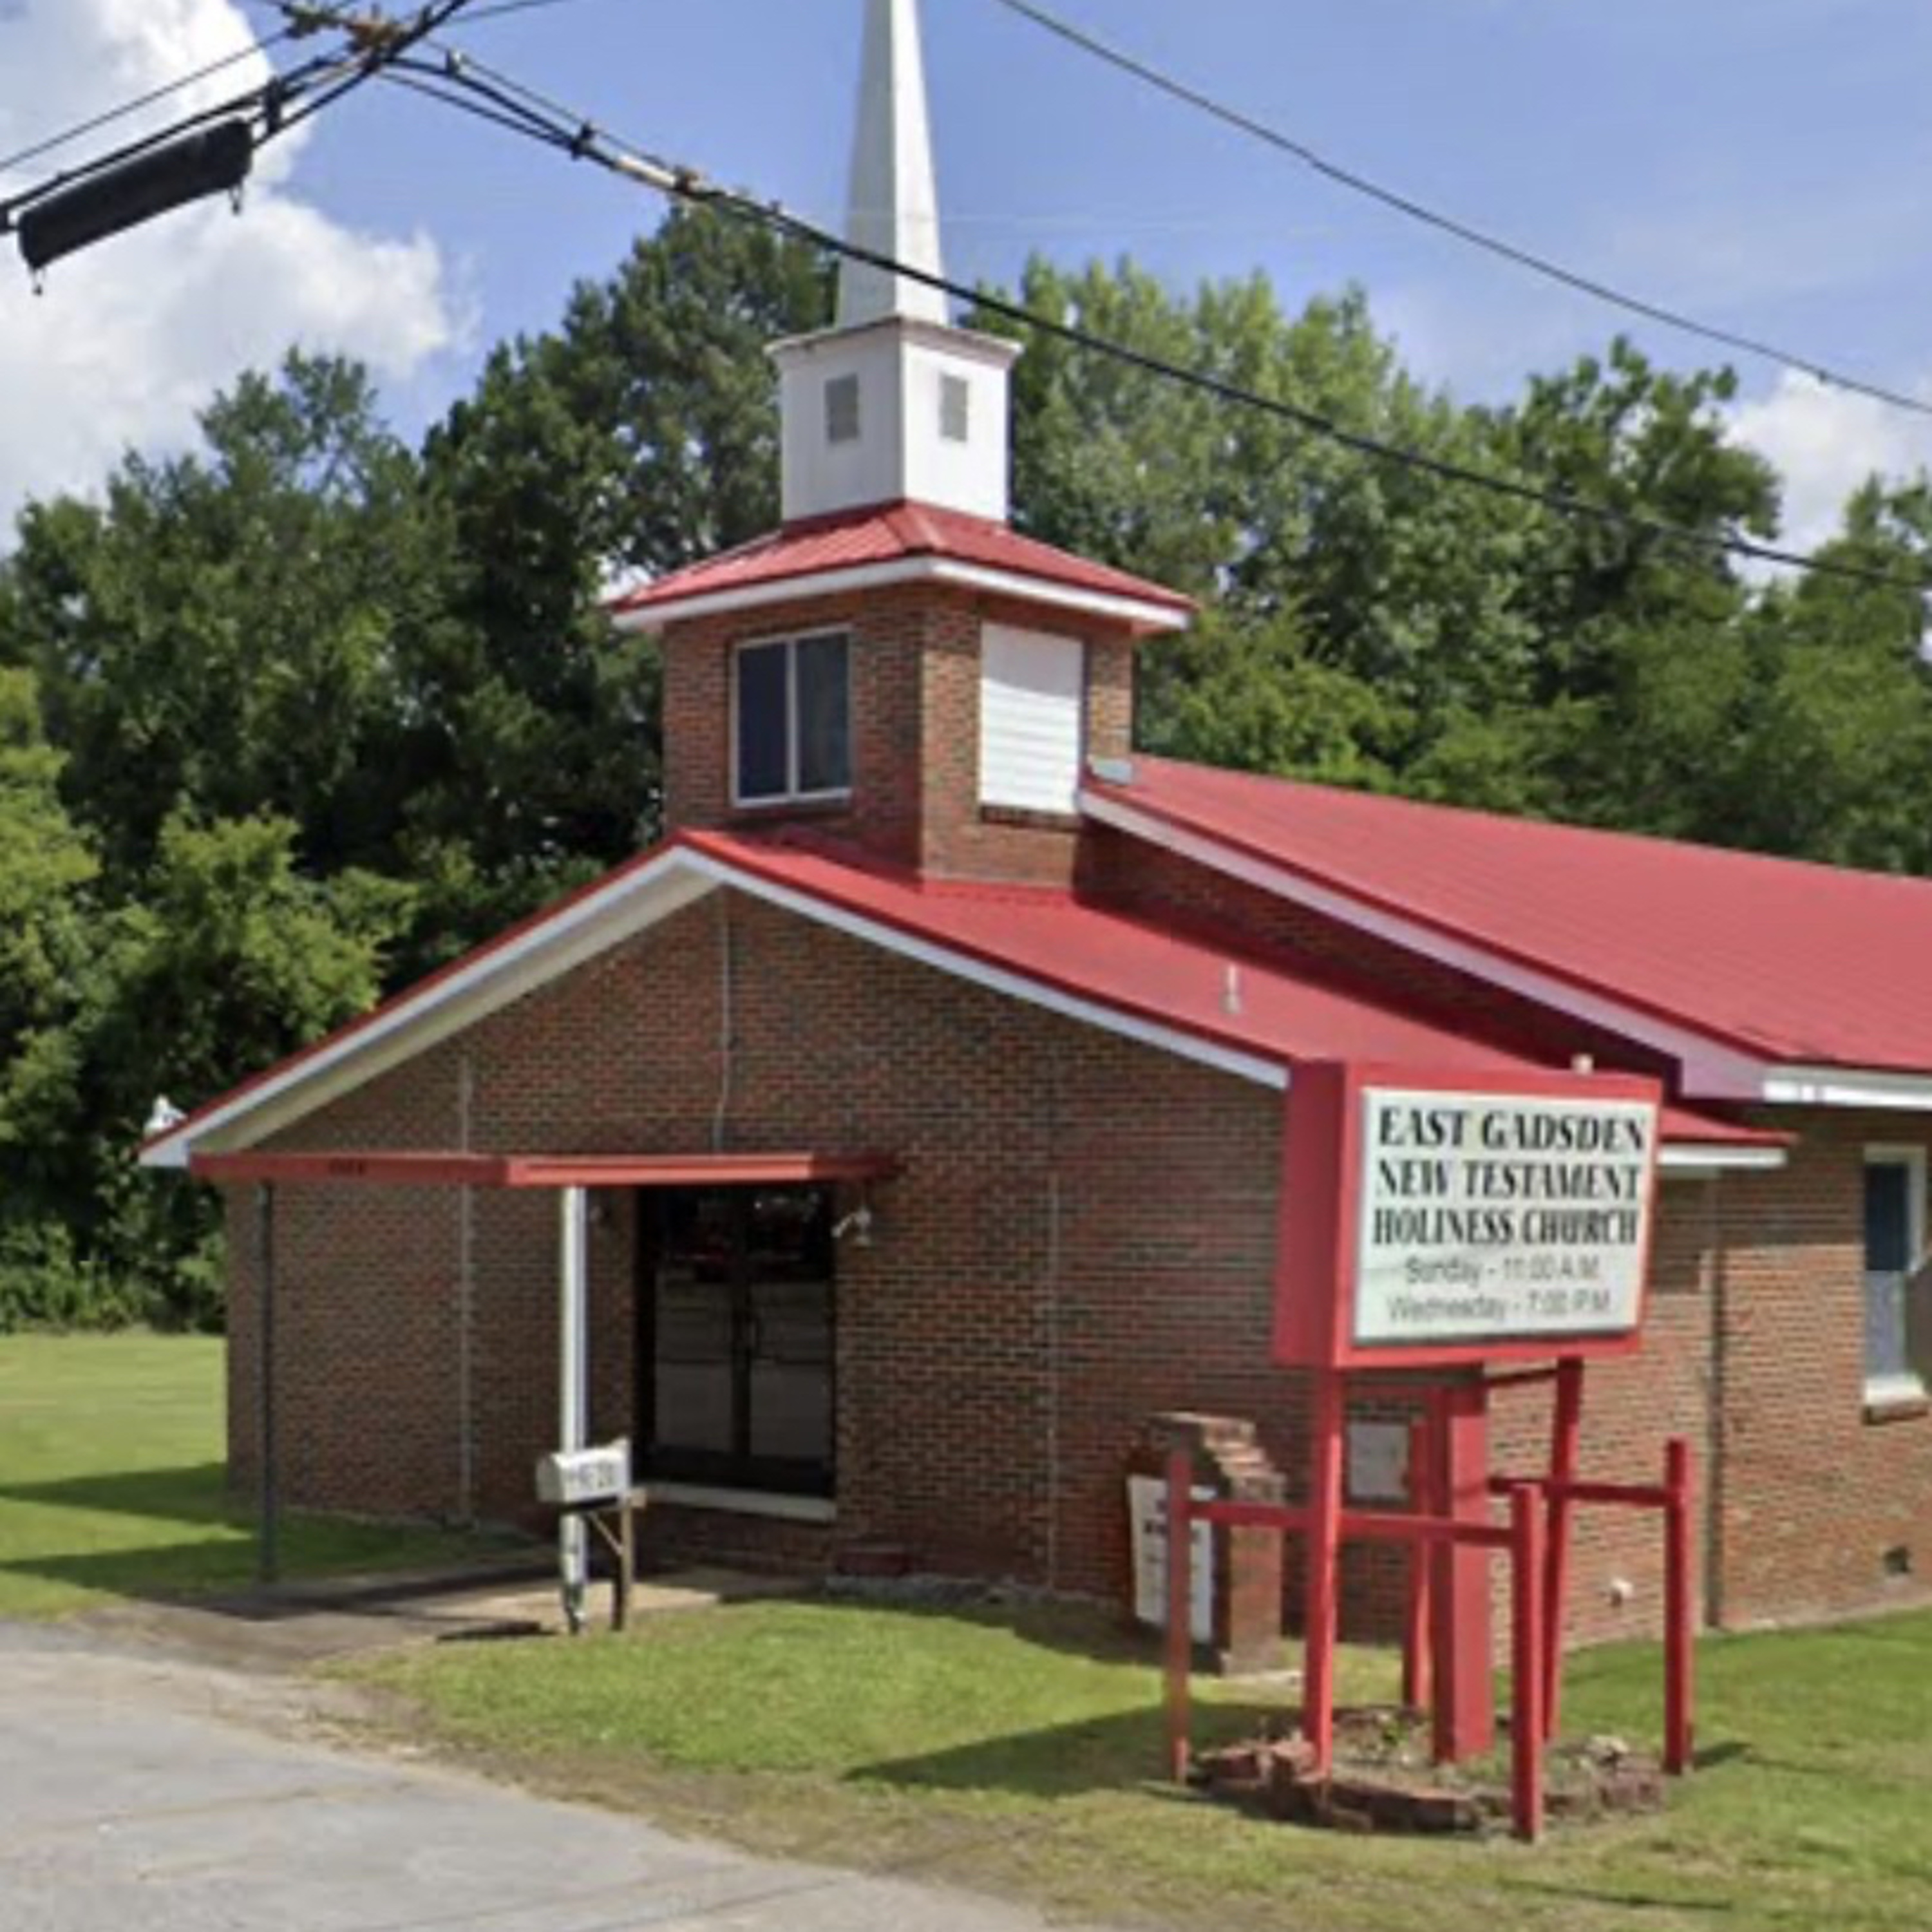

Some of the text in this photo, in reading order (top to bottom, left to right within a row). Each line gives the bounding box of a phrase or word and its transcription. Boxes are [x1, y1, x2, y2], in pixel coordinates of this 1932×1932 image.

[1379, 1106, 1644, 1151] EAST GADSDEN
[1378, 1159, 1640, 1200] NEW TESTAMENT
[1373, 1208, 1638, 1245] HOLINESS CHURCH
[1405, 1255, 1480, 1288] Sunday
